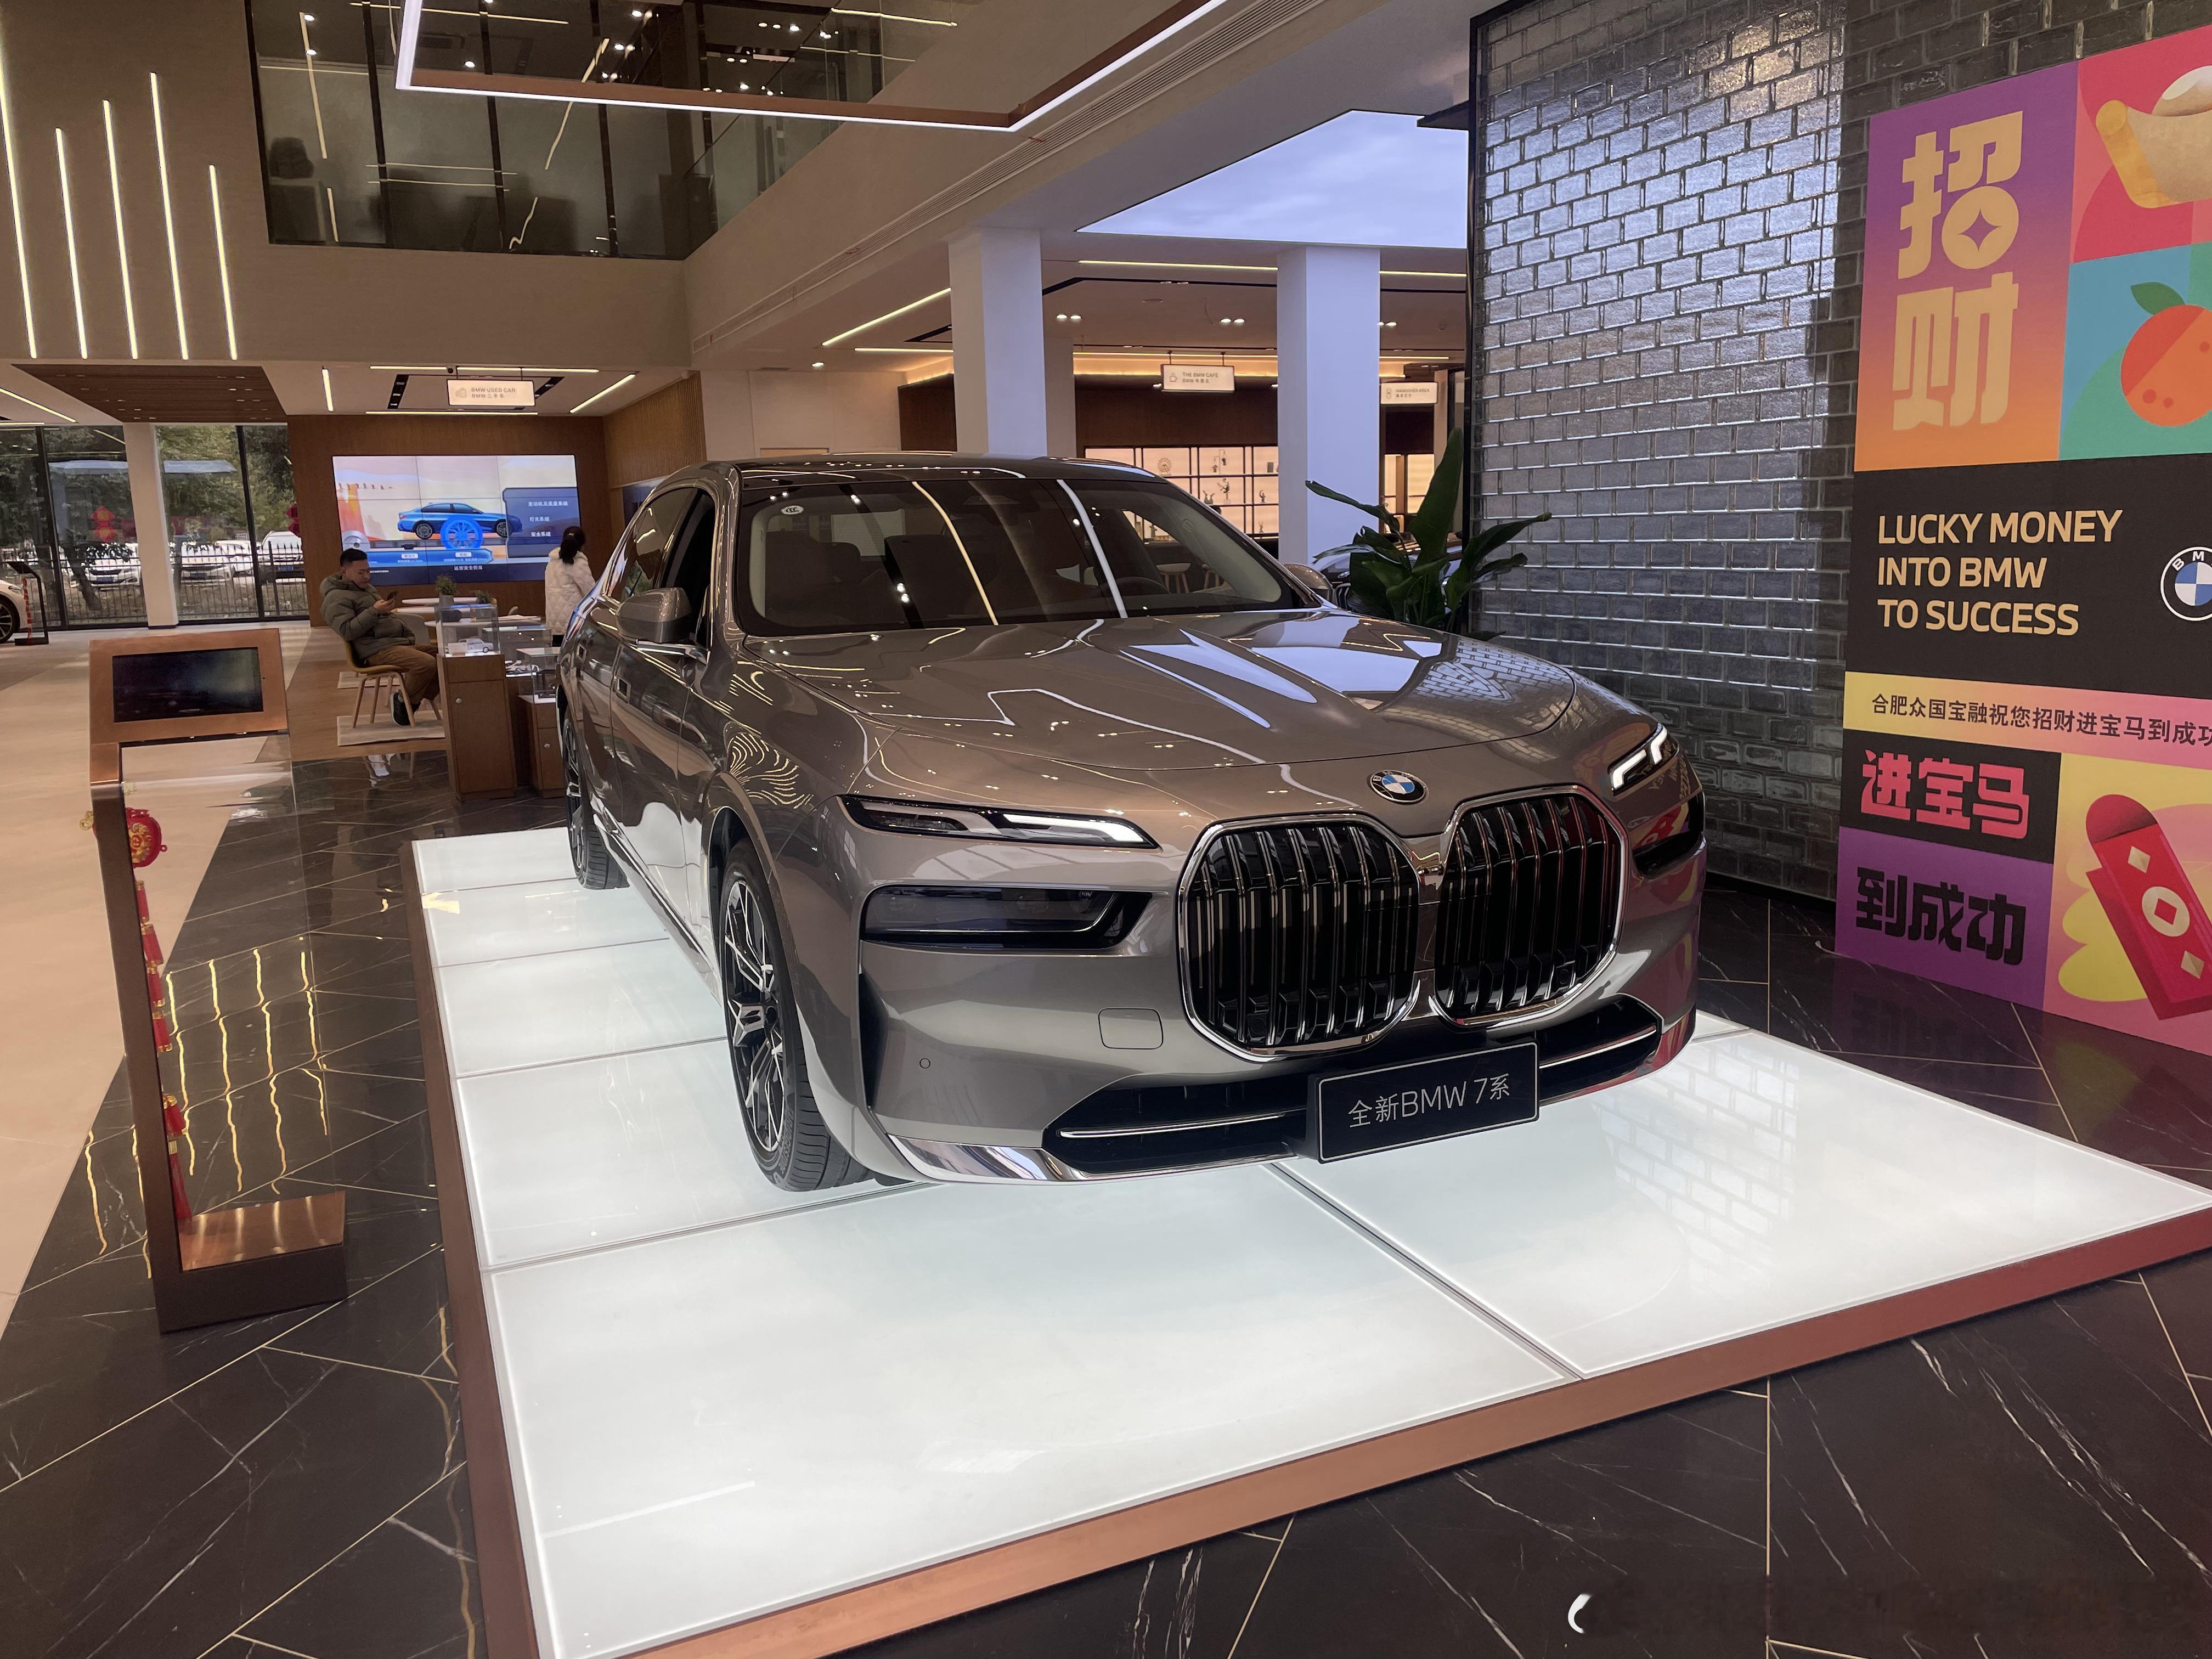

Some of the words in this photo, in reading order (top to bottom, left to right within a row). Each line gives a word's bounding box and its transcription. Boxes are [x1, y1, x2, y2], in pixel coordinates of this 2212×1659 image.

[1878, 513, 1983, 544] LUCKY
[1989, 509, 2124, 544] MONEY
[1877, 556, 1951, 587] INTO
[1959, 556, 2047, 589] BMW
[2172, 551, 2212, 572] BM
[1877, 599, 1919, 629] TO
[1926, 600, 2079, 636] SUCCESS
[1871, 693, 2212, 747] 合肥众国宝融祝您招财进宝马到成功
[1860, 749, 2030, 840] 进宝马
[1855, 866, 2027, 966] 到成功
[1347, 1080, 1466, 1128] 全新BMW
[1474, 1073, 1510, 1105] 7系
